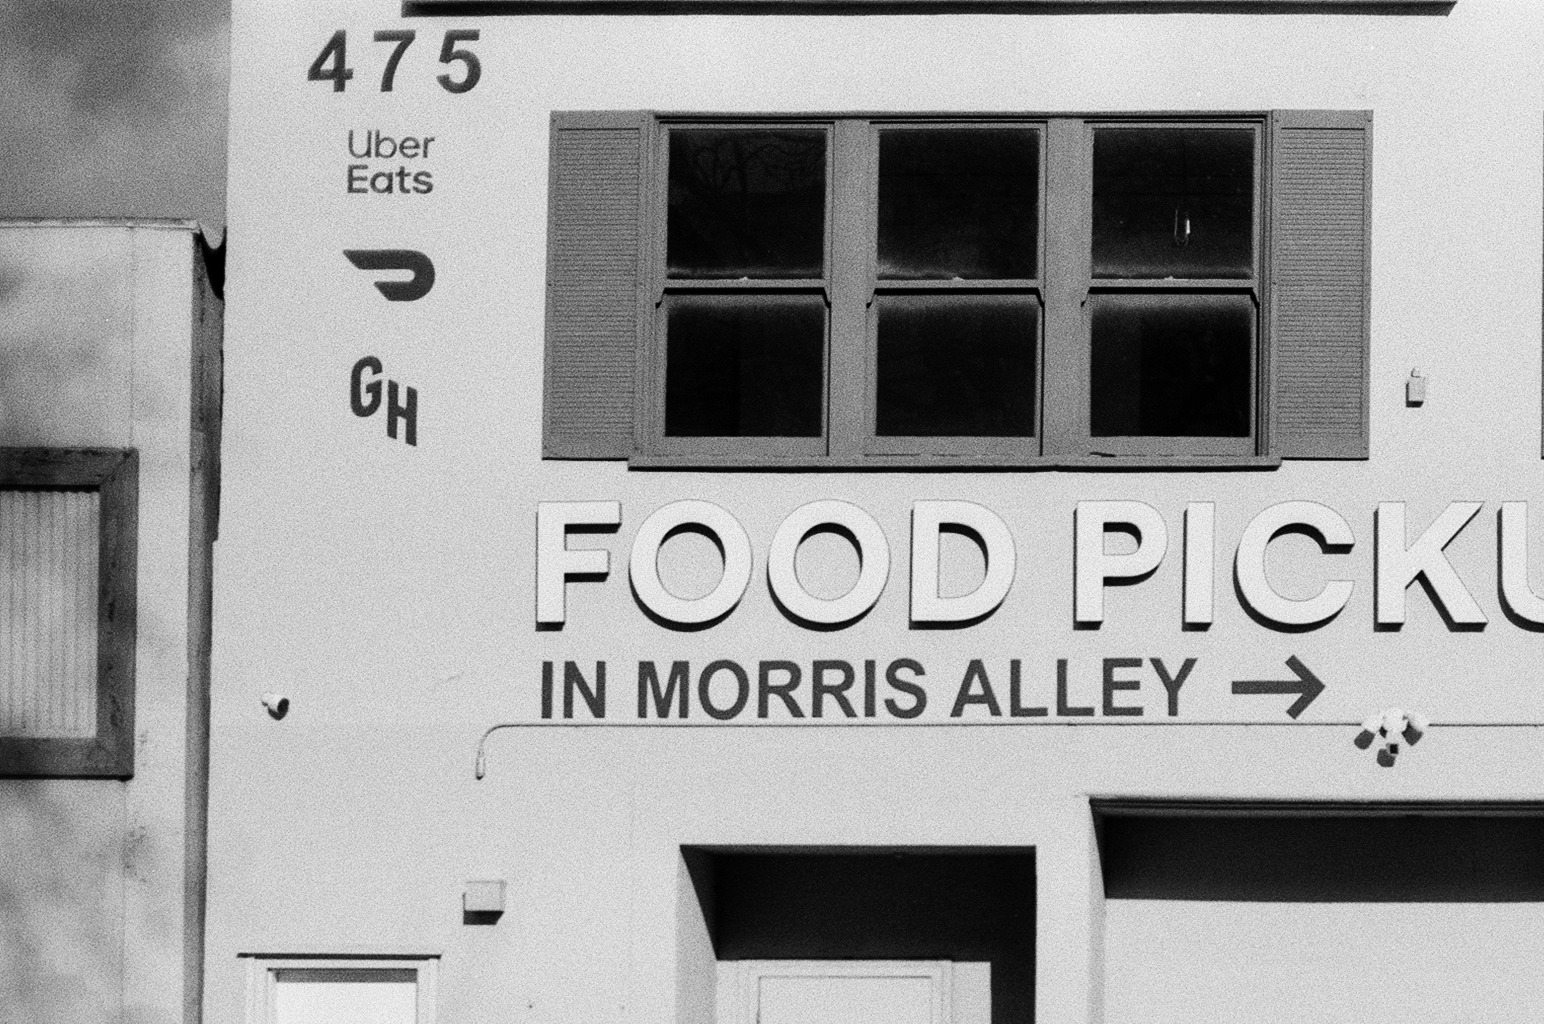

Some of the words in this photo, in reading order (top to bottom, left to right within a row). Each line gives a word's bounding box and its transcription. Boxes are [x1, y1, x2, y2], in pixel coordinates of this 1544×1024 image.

[307, 29, 482, 94] 475
[348, 129, 435, 159] Uber
[346, 164, 434, 194] Eats
[349, 355, 418, 447] GH
[536, 499, 1017, 633] FOOD
[541, 660, 606, 719] IN
[637, 657, 928, 720] MORRIS
[950, 657, 1198, 718] ALLEY
